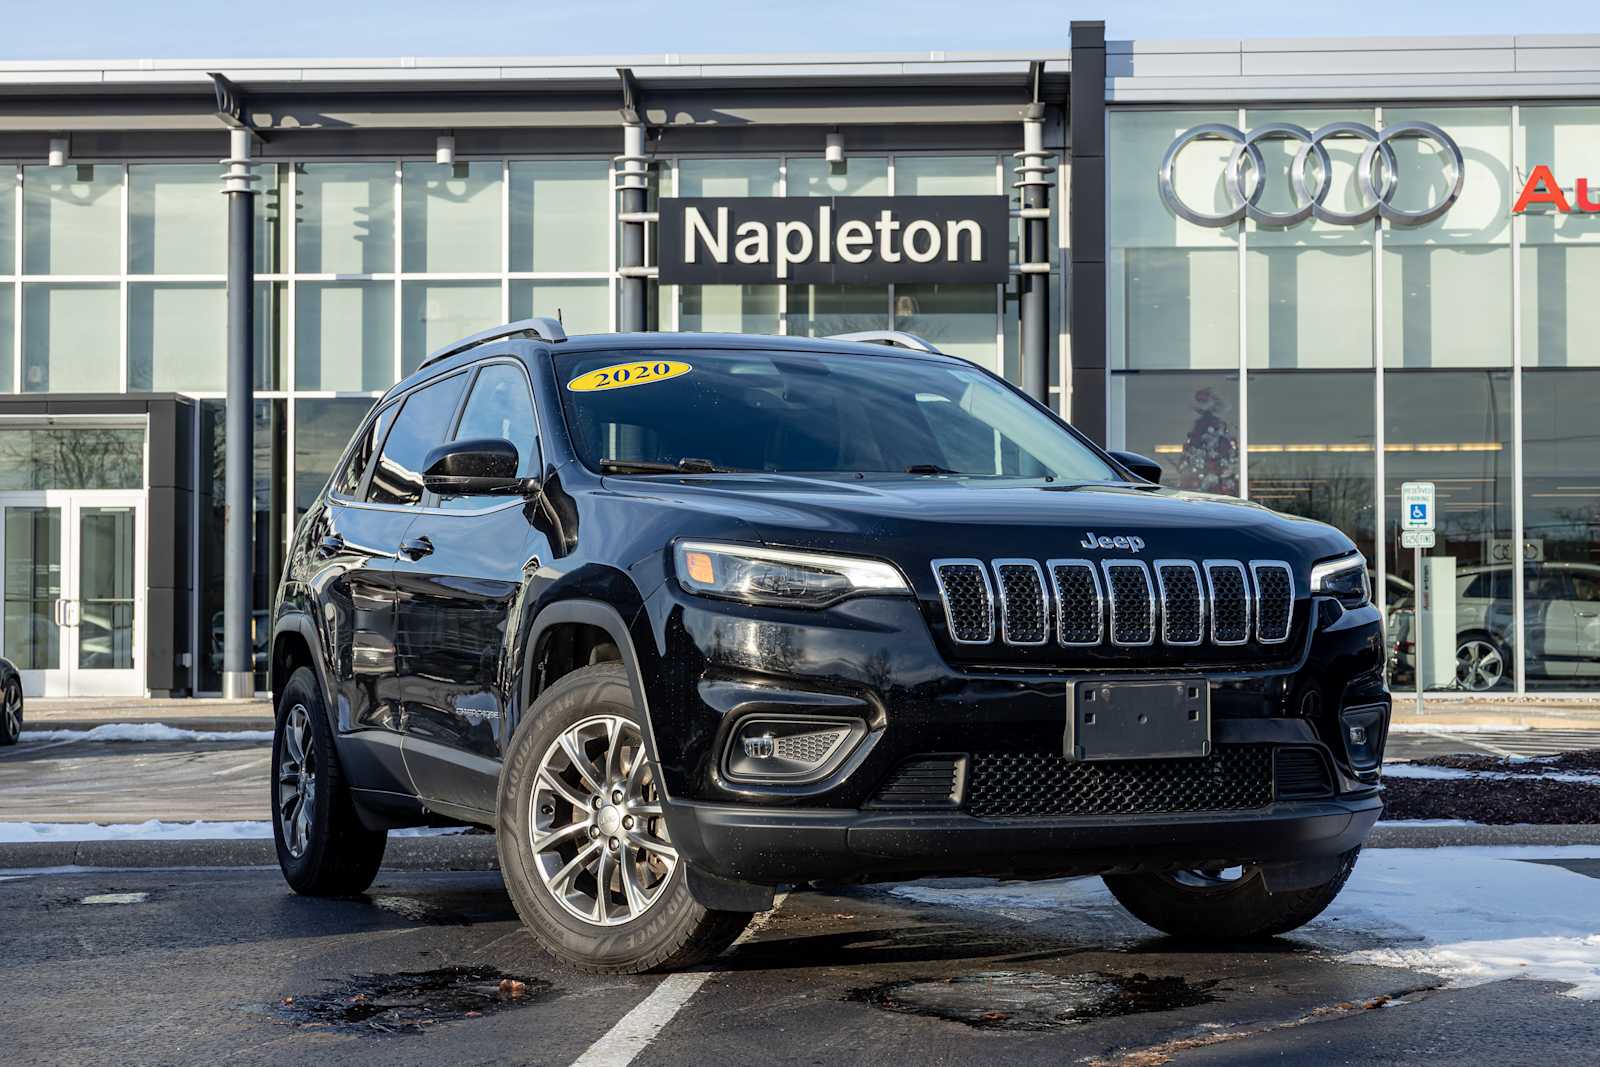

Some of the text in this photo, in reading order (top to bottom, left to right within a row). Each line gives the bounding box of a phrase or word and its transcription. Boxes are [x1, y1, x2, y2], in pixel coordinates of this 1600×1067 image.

[684, 205, 982, 279] Napleton
[594, 362, 670, 388] 2020
[1080, 532, 1146, 553] Jeep
